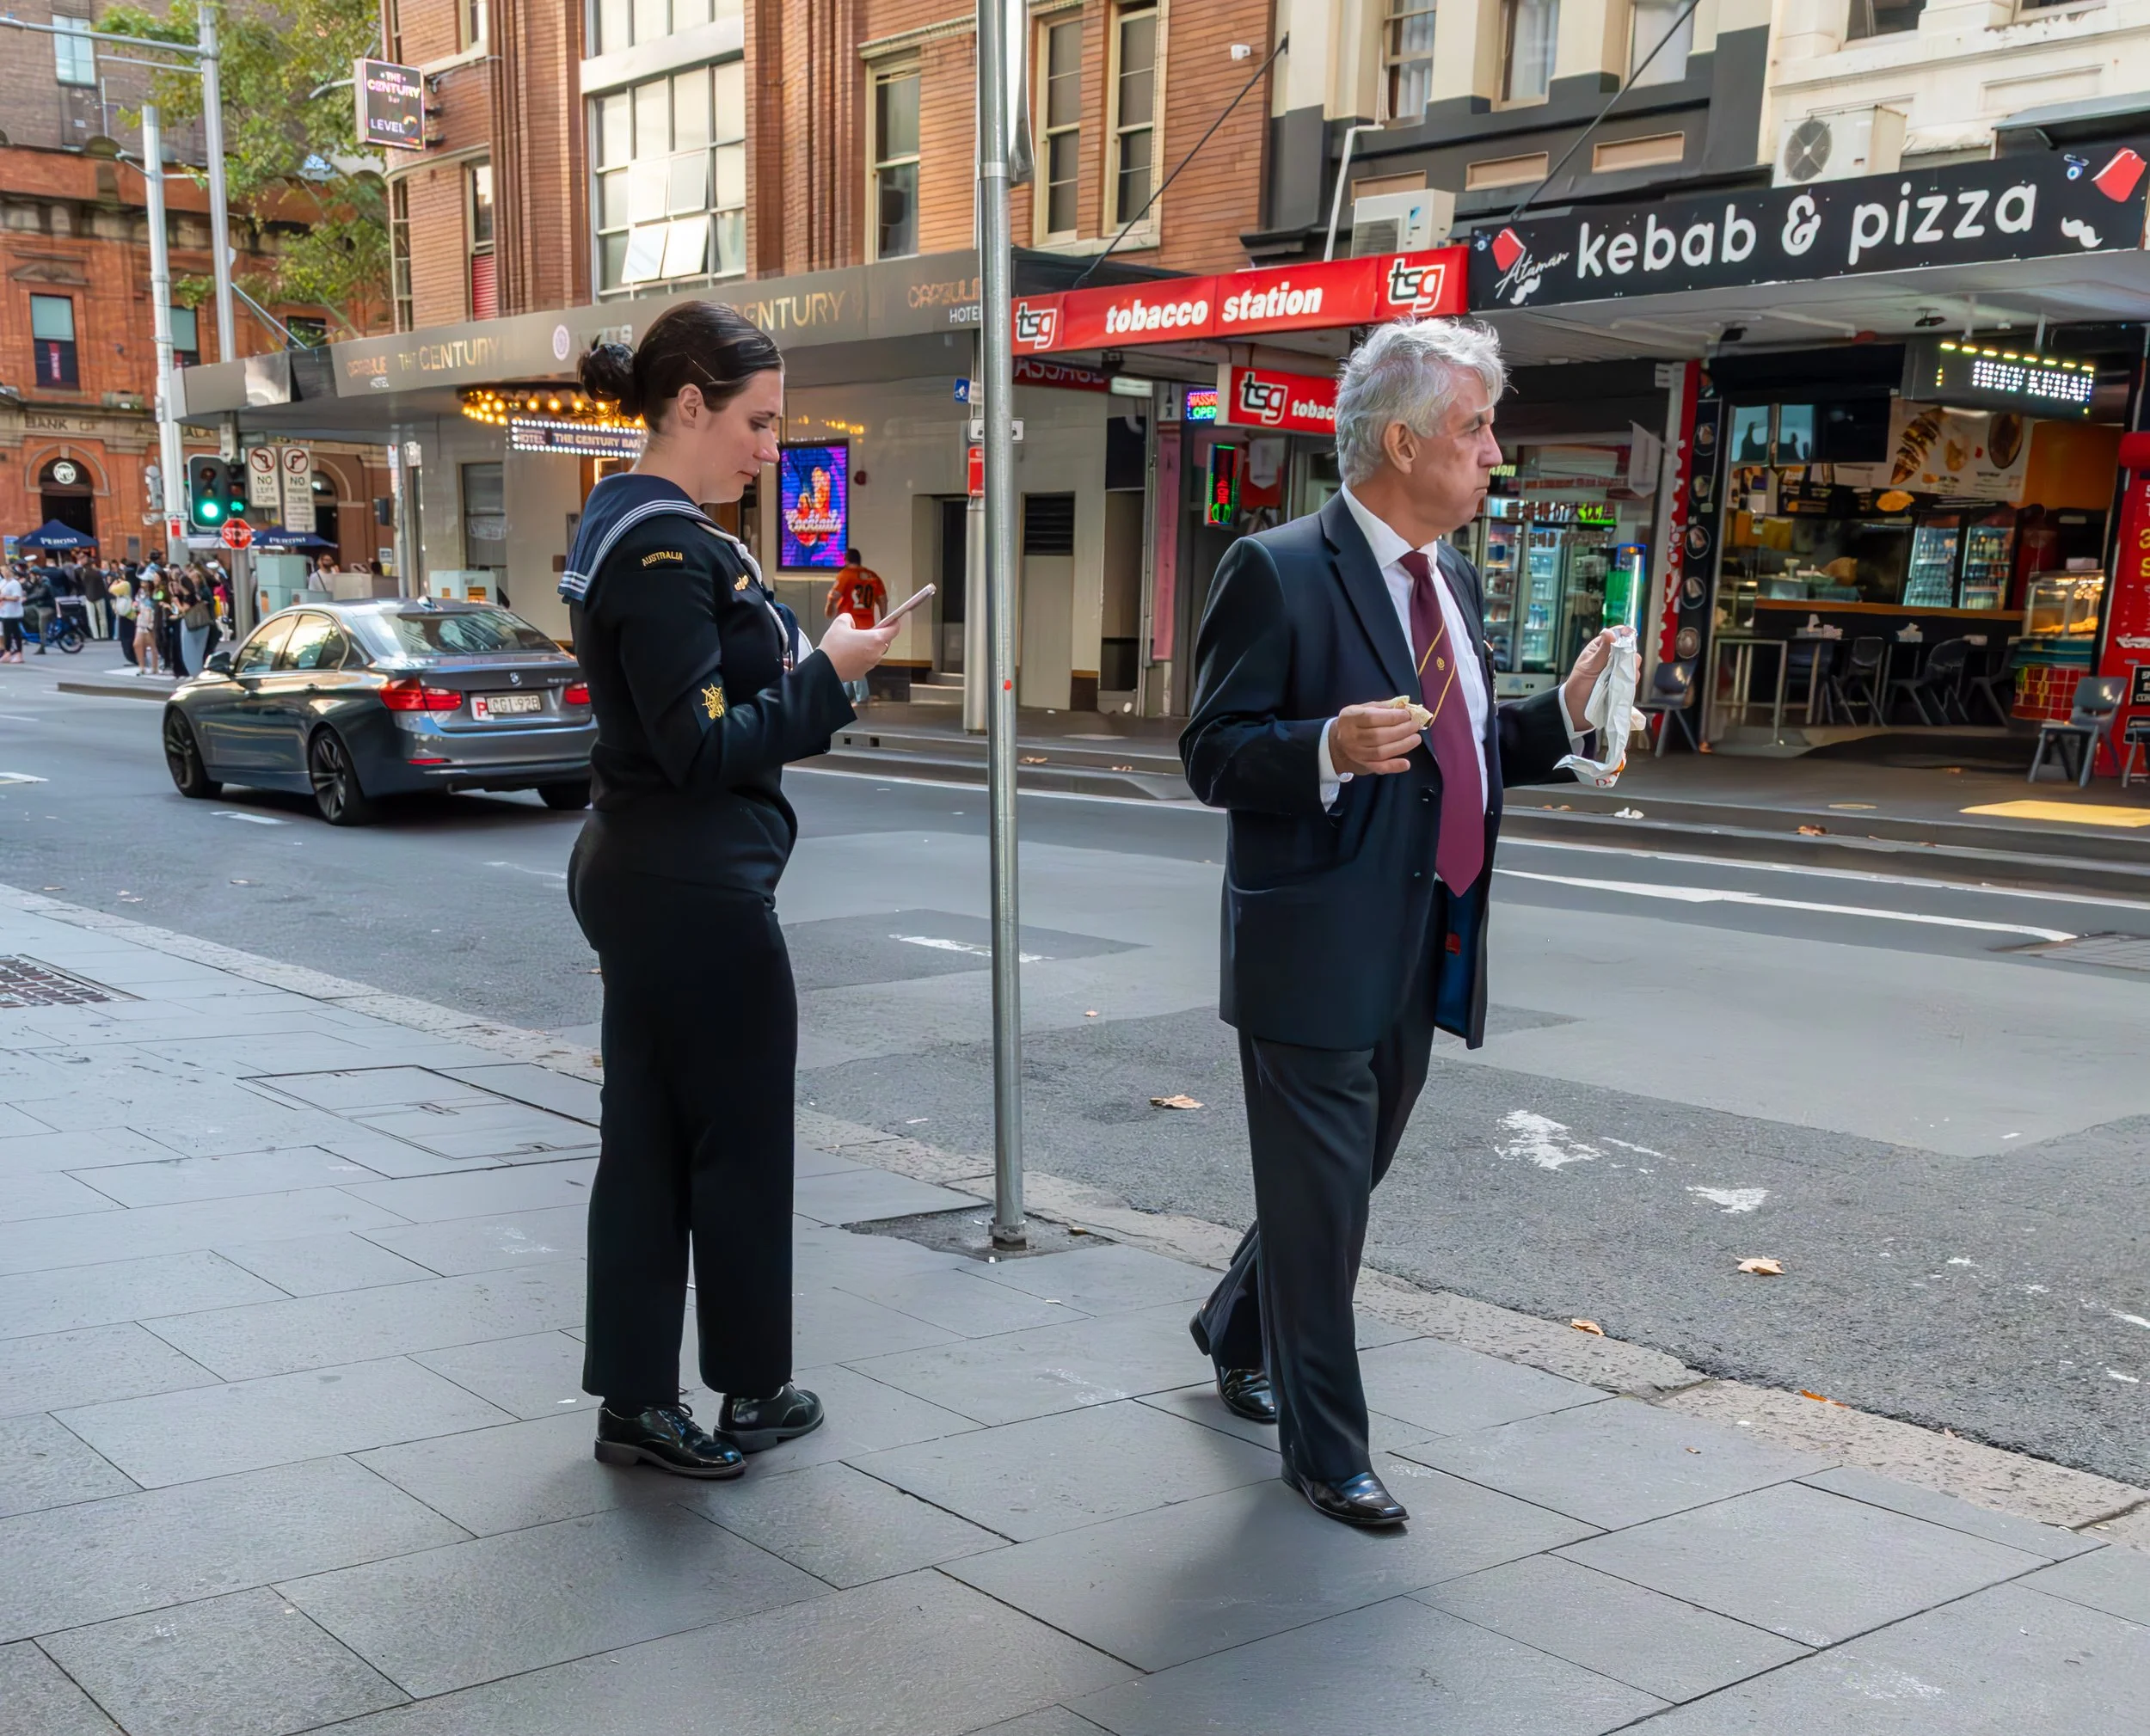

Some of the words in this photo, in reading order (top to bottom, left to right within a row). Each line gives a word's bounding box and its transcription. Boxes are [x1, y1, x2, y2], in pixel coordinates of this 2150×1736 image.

[386, 71, 401, 83] THE
[367, 79, 421, 98] CENTURY
[370, 119, 405, 133] LEVEL
[1577, 204, 1757, 279] kebab
[1781, 194, 1821, 256] &
[1848, 181, 2036, 266] pizza
[1387, 258, 1445, 313] tsg
[949, 305, 980, 323] HOTE
[1105, 299, 1207, 334] tobacco
[1222, 281, 1323, 322] station
[1016, 302, 1057, 349] tsg
[418, 336, 499, 371] CENTURY
[1239, 371, 1287, 425] tsg
[1292, 399, 1335, 420] tobac
[25, 414, 68, 431] BANK
[554, 432, 574, 445] THE
[575, 434, 620, 448] CENTURY
[257, 475, 273, 485] NO
[290, 475, 305, 486] NO
[225, 527, 251, 539] STOP
[269, 537, 307, 545] PERONI
[642, 551, 683, 567] AUSTRALIA
[476, 701, 488, 717] P
